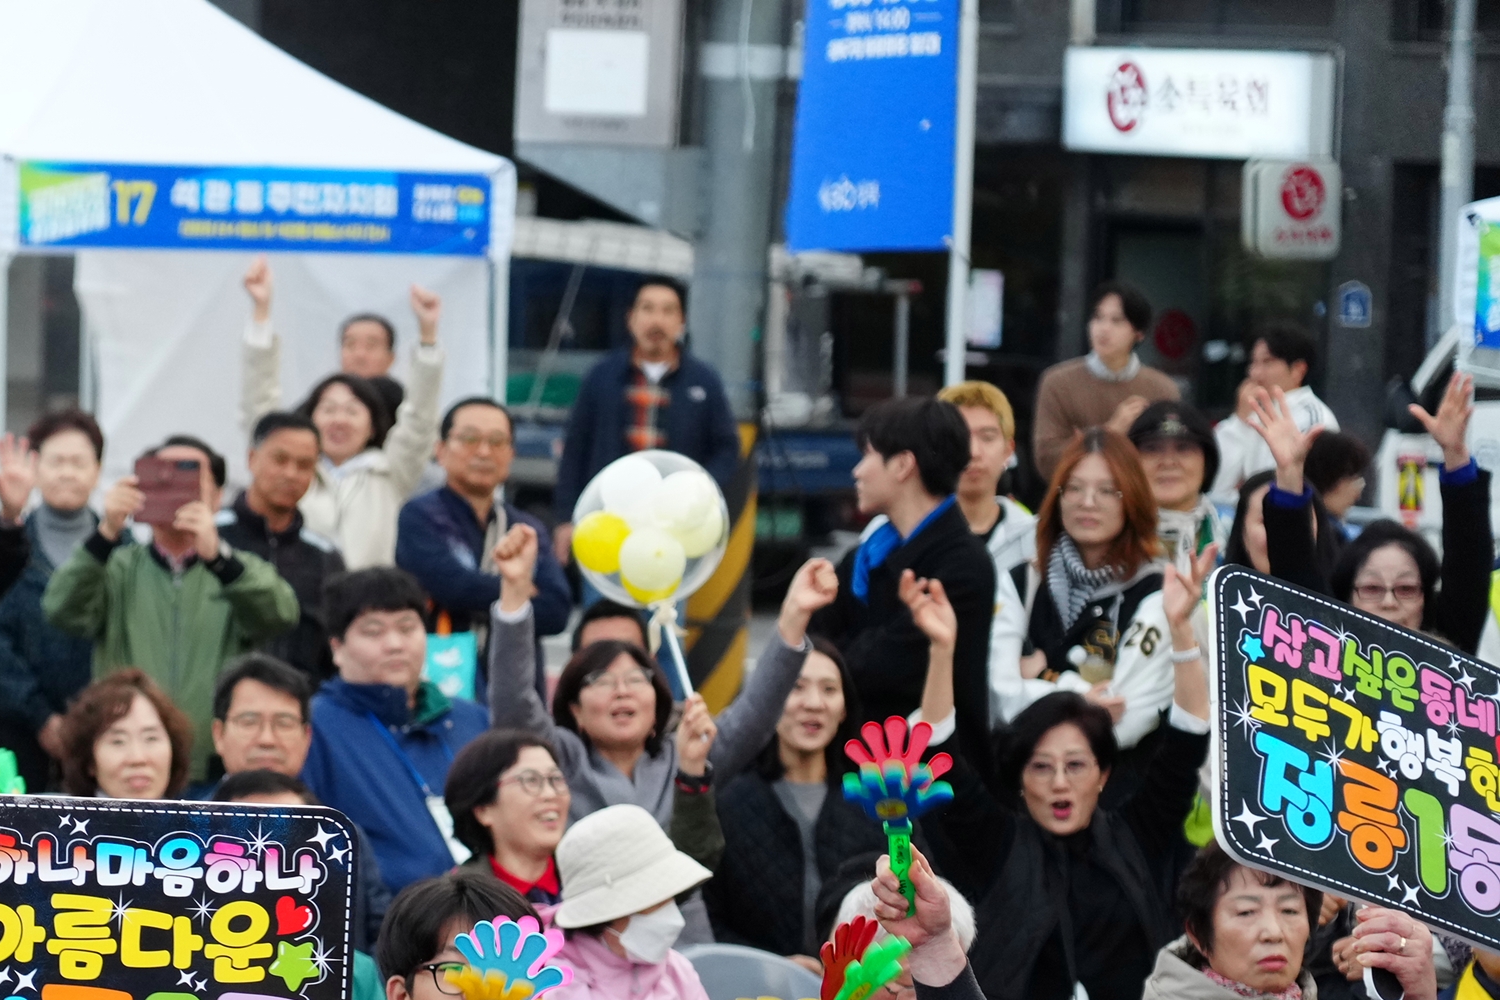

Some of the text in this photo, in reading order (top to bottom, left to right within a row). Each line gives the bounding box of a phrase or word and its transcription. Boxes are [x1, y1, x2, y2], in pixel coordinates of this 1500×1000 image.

[114, 180, 157, 225] 17
[1124, 621, 1162, 657] 26
[1255, 732, 1500, 912] 정릉1동
